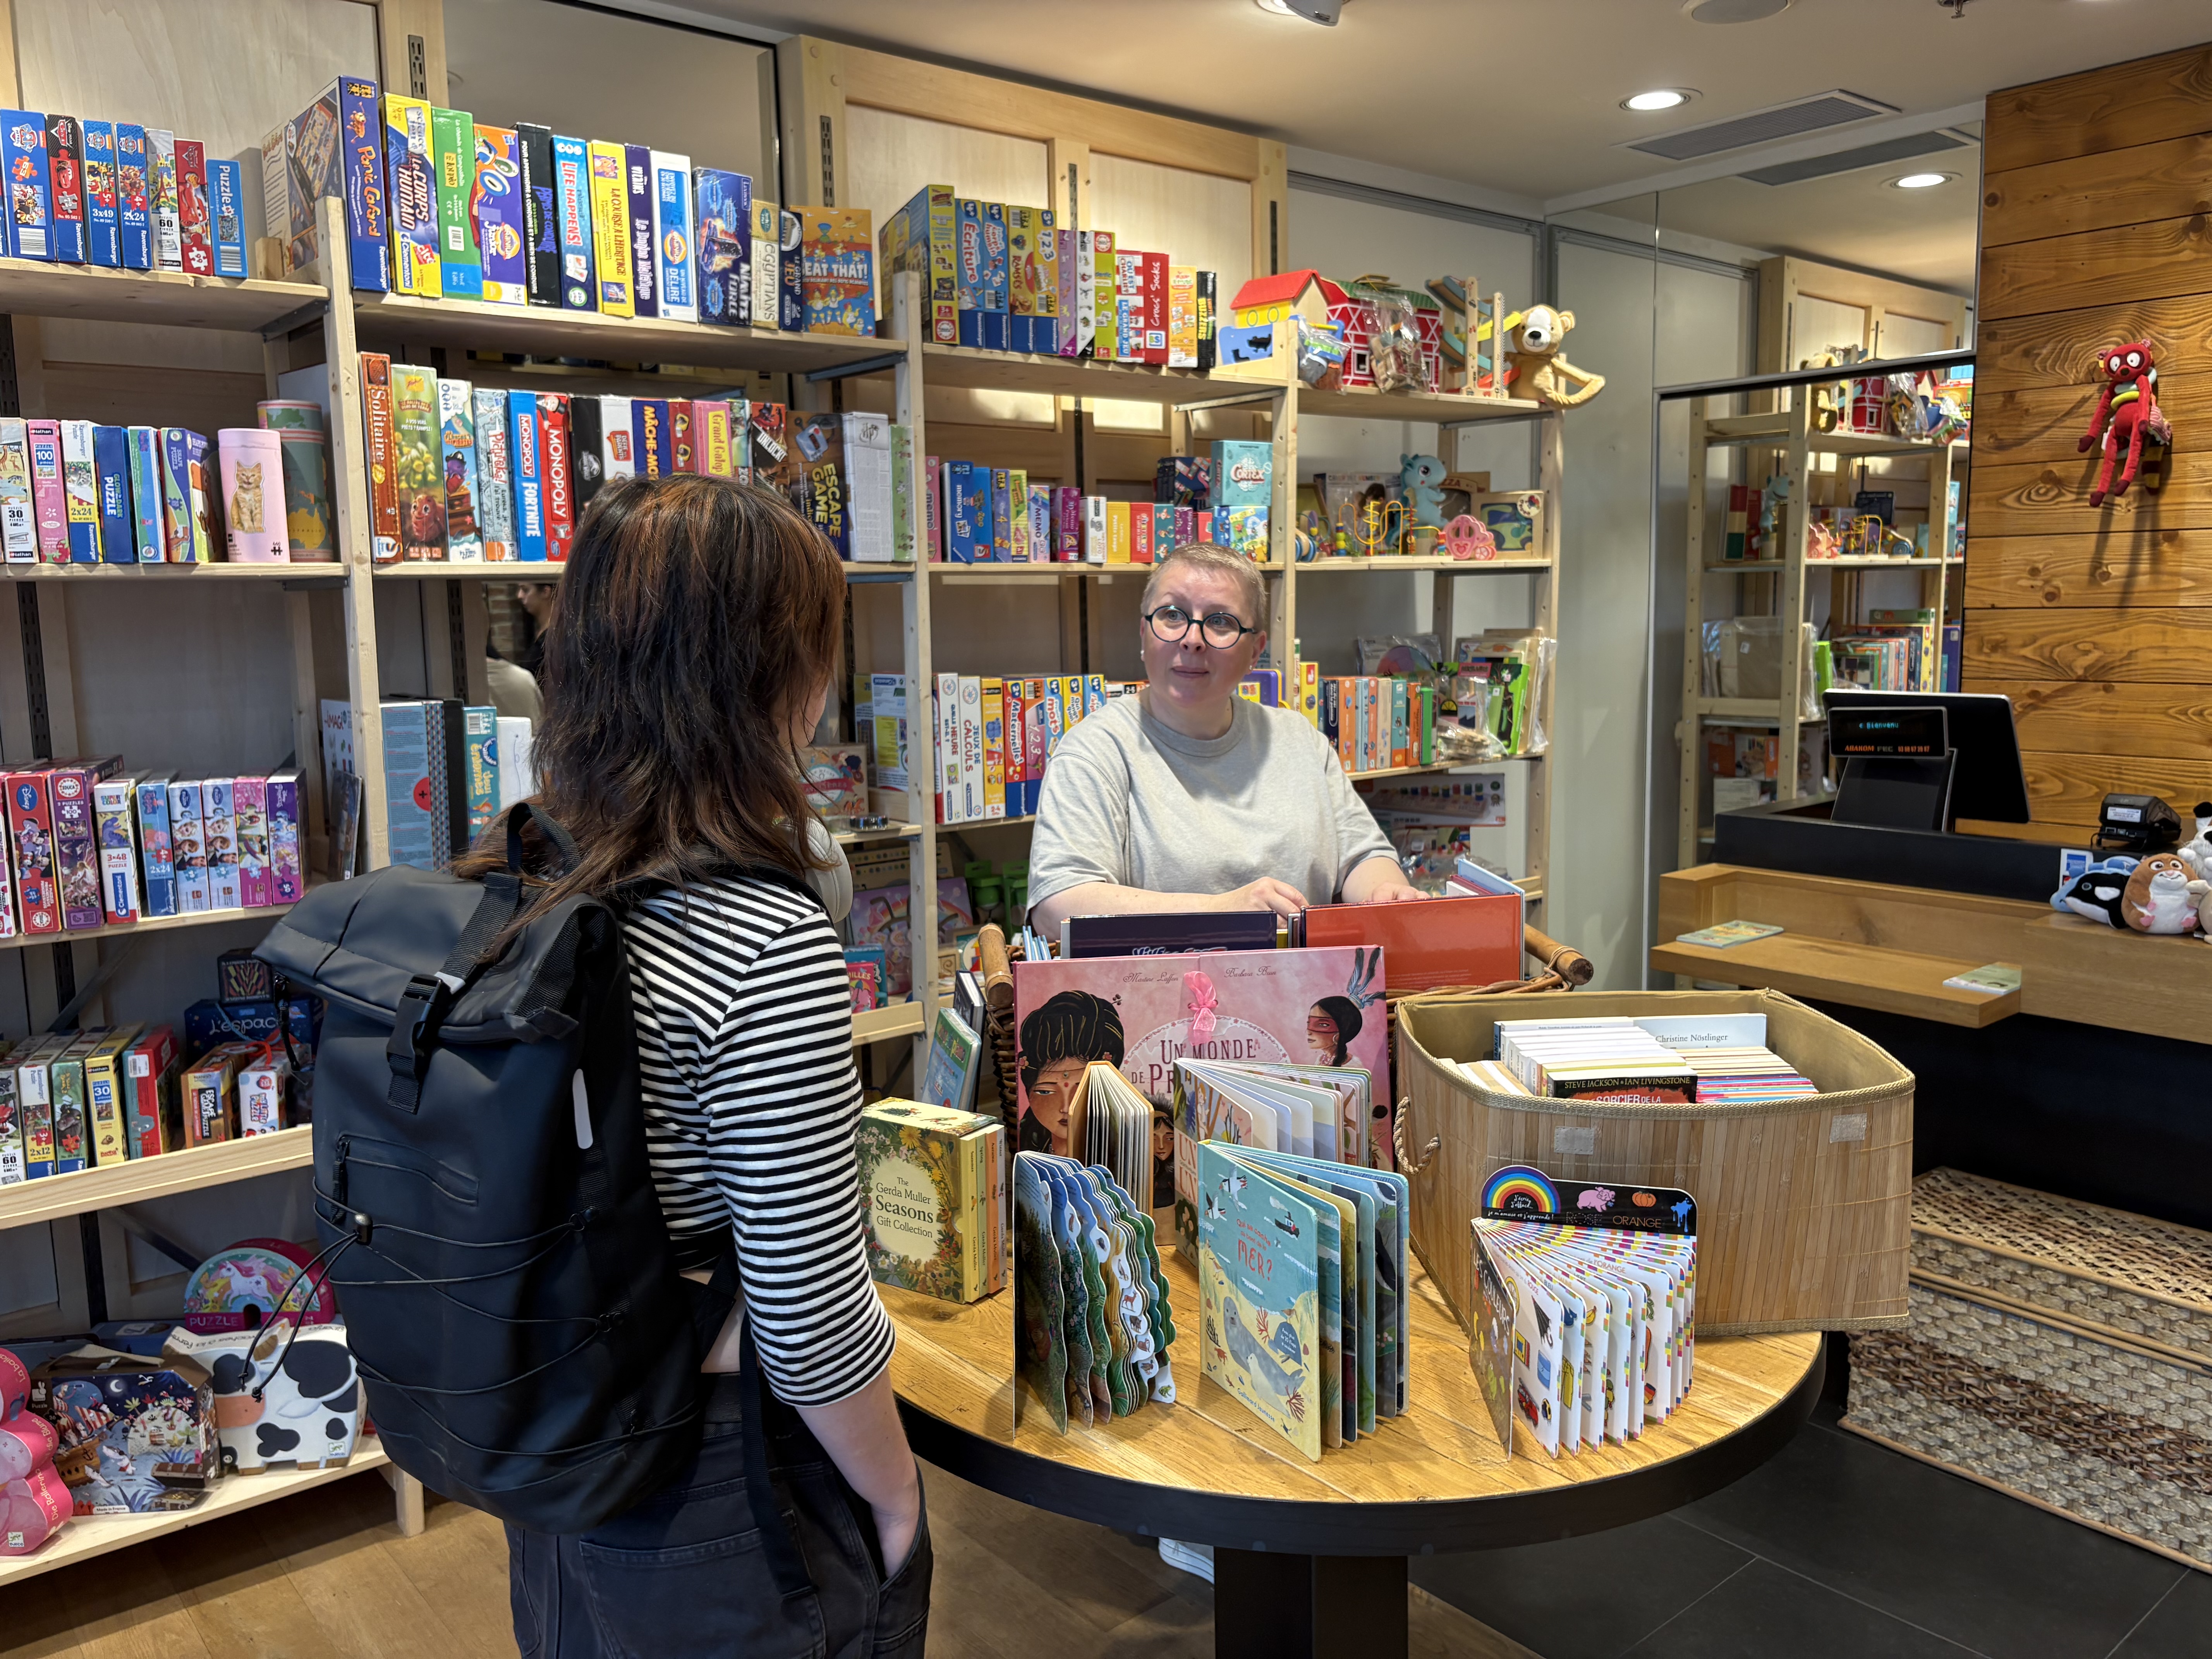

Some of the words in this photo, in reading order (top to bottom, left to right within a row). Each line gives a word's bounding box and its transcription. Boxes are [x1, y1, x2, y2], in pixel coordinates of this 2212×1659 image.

[20, 163, 29, 175] 63
[358, 146, 376, 184] Panic
[523, 159, 531, 193] APPRENDRE
[560, 160, 578, 187] LIFE
[631, 166, 644, 195] VILAINS
[101, 193, 113, 203] 5+
[398, 165, 416, 230] HUMAIN
[414, 169, 429, 222] CORPS
[532, 186, 554, 210] PERMIS
[93, 208, 114, 218] 3x49
[124, 211, 145, 222] 2x24
[159, 219, 173, 228] 60
[364, 187, 381, 237] Cafard
[544, 211, 554, 220] DE
[565, 187, 584, 247] HAPPENS!
[612, 198, 623, 228] COURSE
[635, 218, 649, 230] Le
[75, 222, 84, 261] Ravensburger
[536, 221, 557, 254] CONDUIRE
[634, 230, 651, 260] Donjon
[401, 242, 414, 288] Clementoni
[963, 222, 980, 283] Écriture
[762, 243, 775, 321] EGYPTIANS
[784, 260, 795, 286] JEU
[794, 264, 802, 295] GRAND
[832, 264, 868, 280] THAT!
[1122, 302, 1128, 311] LE
[369, 388, 387, 462] Solitaire
[711, 414, 723, 445] Grand
[36, 451, 53, 460] 100
[79, 424, 88, 459] Ravensburger
[520, 415, 532, 476] MONOPOLY
[757, 431, 788, 462] UNLOCK!
[549, 429, 567, 518] MONOPOLY
[712, 446, 723, 473] Galop
[104, 476, 117, 516] PUZZLE
[522, 482, 541, 537] FORTNITE
[812, 467, 828, 524] GAME
[823, 463, 842, 538] ESCAPE
[955, 484, 963, 519] memory
[9, 510, 23, 518] 30
[71, 508, 92, 516] 2x24
[88, 524, 96, 560] Ravensburger
[1010, 683, 1021, 697] 2+
[1125, 686, 1136, 694] 2-5
[1047, 697, 1060, 734] mots
[950, 726, 959, 756] HEURE
[963, 719, 974, 773] CALCULS
[1010, 699, 1024, 766] Maternelle!
[974, 751, 981, 765] DE
[1123, 972, 1154, 983] Martine
[1223, 967, 1254, 978] Barbara
[209, 1016, 281, 1036] L'espac
[1655, 1032, 1688, 1043] Christine
[1690, 1031, 1729, 1044] Nöstlinger
[1161, 1039, 1183, 1065] UN
[1193, 1038, 1257, 1060] MONDE
[1131, 1071, 1146, 1084] DE
[1564, 1080, 1586, 1089] STEVE
[1587, 1079, 1619, 1088] JACKSON
[1625, 1078, 1639, 1086] IAN
[1641, 1076, 1690, 1085] LIVINGSTONE
[94, 1087, 110, 1097] 30
[205, 1089, 216, 1118] ESCAPE
[30, 1147, 51, 1157] 2x12
[1178, 1133, 1197, 1167] UN
[876, 1182, 902, 1197] Gerda
[905, 1190, 931, 1205] Muller
[896, 1176, 909, 1187] The
[1178, 1166, 1198, 1204] UN
[876, 1195, 934, 1224] Seasons
[1494, 1209, 1516, 1218] m'amuse
[1566, 1211, 1603, 1226] ROSE
[1612, 1214, 1662, 1229] ORANGE
[876, 1216, 891, 1228] Gift
[893, 1219, 933, 1238] Collection
[1593, 1257, 1626, 1274] l'ORANGE
[1474, 1248, 1483, 1279] LES
[1483, 1269, 1511, 1337] COULEURS
[1527, 1280, 1539, 1296] ROUGE
[1544, 1279, 1554, 1291] BLEU
[1237, 1388, 1257, 1407] Gallimard
[1257, 1403, 1276, 1422] Jeunesse
[51, 1505, 59, 1521] Die
